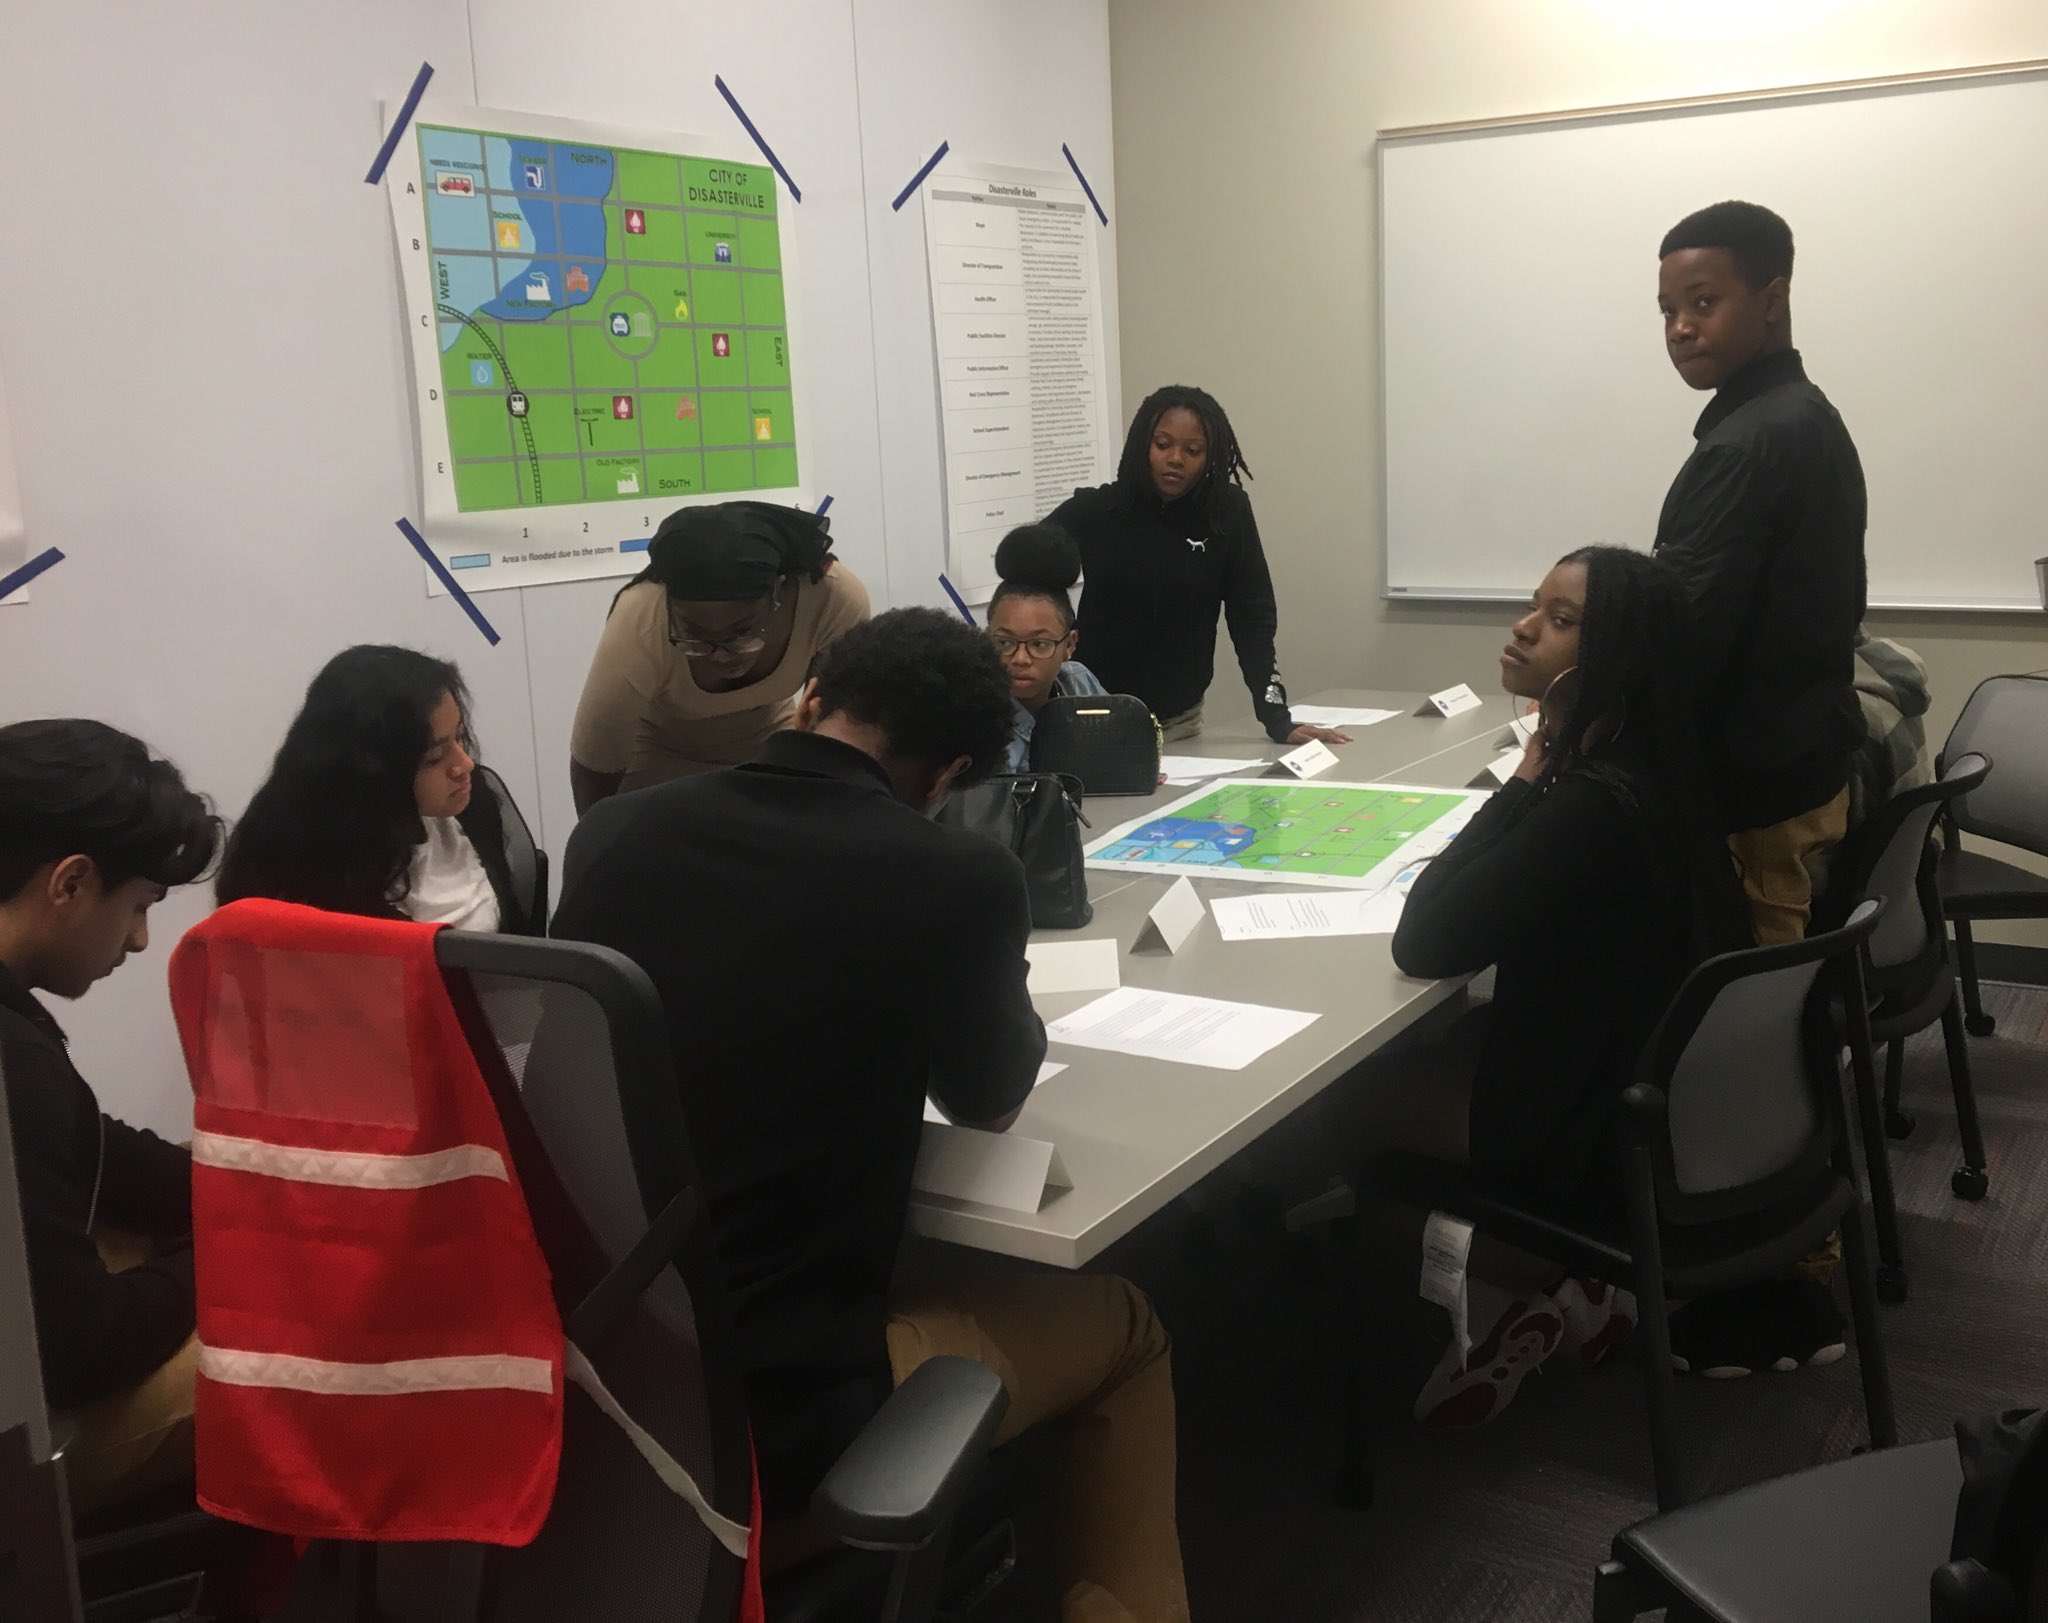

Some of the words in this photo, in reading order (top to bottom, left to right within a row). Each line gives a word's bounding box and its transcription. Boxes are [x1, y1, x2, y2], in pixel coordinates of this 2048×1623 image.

[570, 152, 608, 165] NORTH
[708, 168, 732, 183] CITY
[736, 172, 748, 186] OF
[406, 182, 416, 194] A
[988, 184, 1022, 197] Disasterville
[1022, 188, 1037, 198] Roles
[688, 186, 764, 208] DISASTERVILLE
[412, 238, 420, 250] B
[438, 261, 450, 299] WEST
[422, 315, 428, 327] C
[774, 336, 783, 367] EAST
[430, 390, 438, 400] D
[438, 462, 444, 474] E
[596, 458, 610, 466] OLD
[659, 480, 691, 489] SOUTH
[583, 522, 589, 532] 2
[644, 516, 650, 527] 3
[522, 528, 529, 538] 1
[502, 554, 520, 563] Area
[520, 554, 527, 562] is
[529, 552, 557, 561] flooded
[558, 550, 571, 558] due
[594, 546, 614, 555] storm
